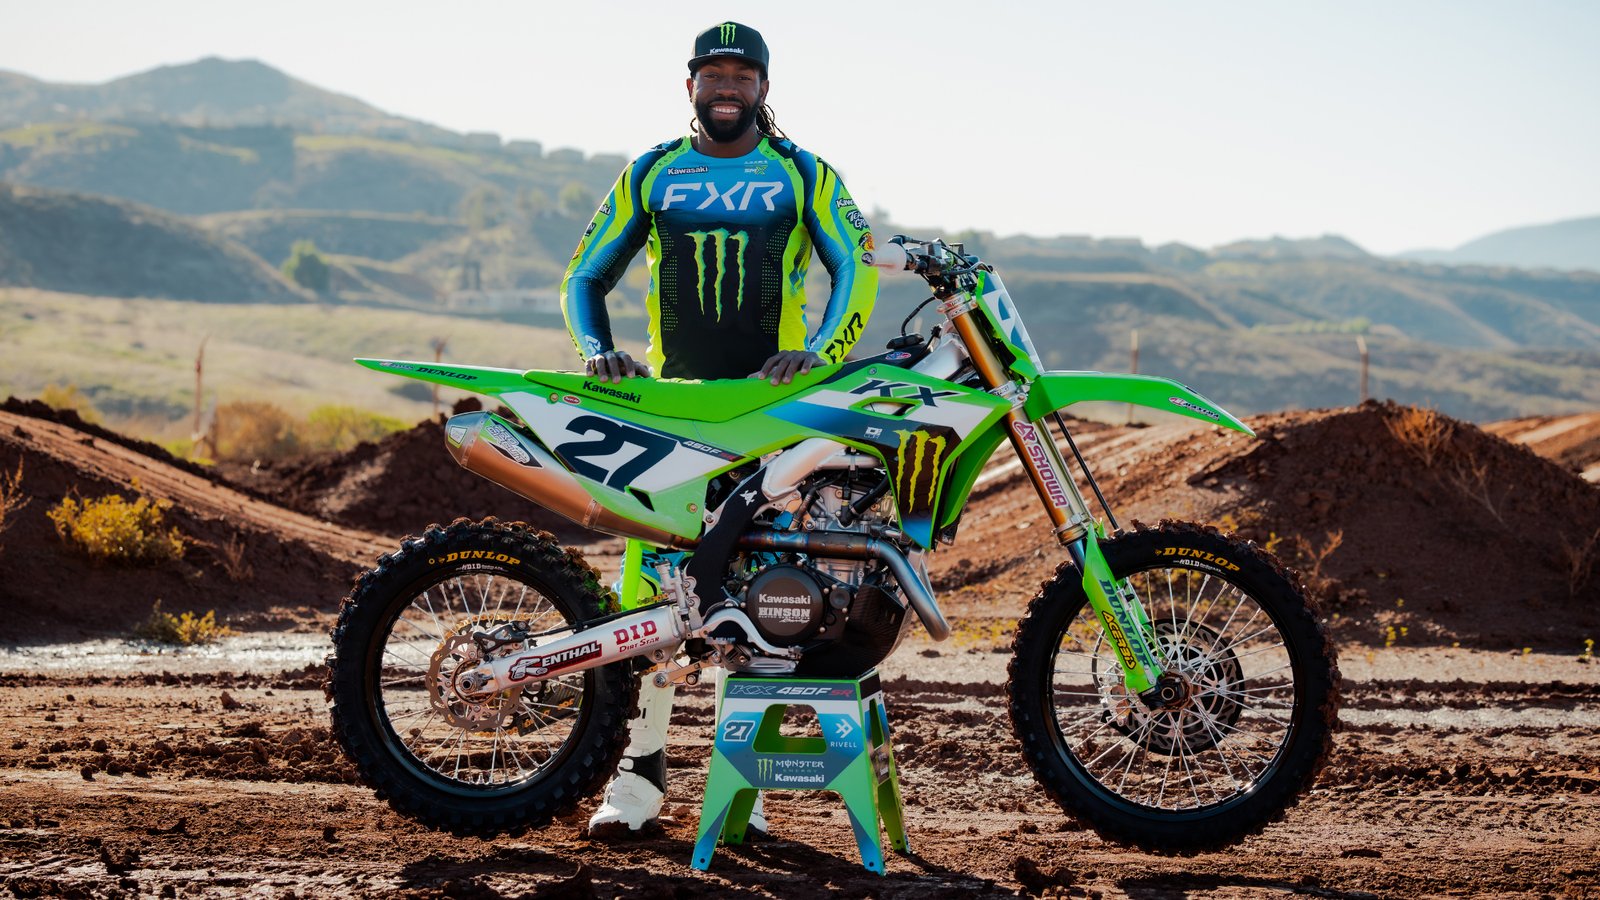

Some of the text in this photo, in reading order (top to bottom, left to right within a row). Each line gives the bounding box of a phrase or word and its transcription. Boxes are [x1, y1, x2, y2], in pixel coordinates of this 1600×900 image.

[709, 47, 745, 55] Kawasaki
[667, 165, 709, 176] Kawasaki
[660, 181, 785, 211] FXR
[825, 312, 863, 364] FXR
[416, 367, 478, 380] DUNLOP
[583, 381, 642, 404] Kawasaki
[849, 379, 960, 407] KX
[553, 415, 678, 493] 27
[682, 440, 723, 454] 450F
[1027, 445, 1067, 507] SHOWA
[446, 550, 521, 565] DUNLOP
[1162, 547, 1241, 572] DUNLOP
[758, 593, 811, 605] Kawasaki
[758, 606, 811, 618] HINSON
[730, 685, 776, 695] KX
[776, 687, 832, 695] 450F
[723, 720, 755, 741] 27
[775, 760, 825, 768] MONSTER
[775, 773, 825, 783] Kawasaki
